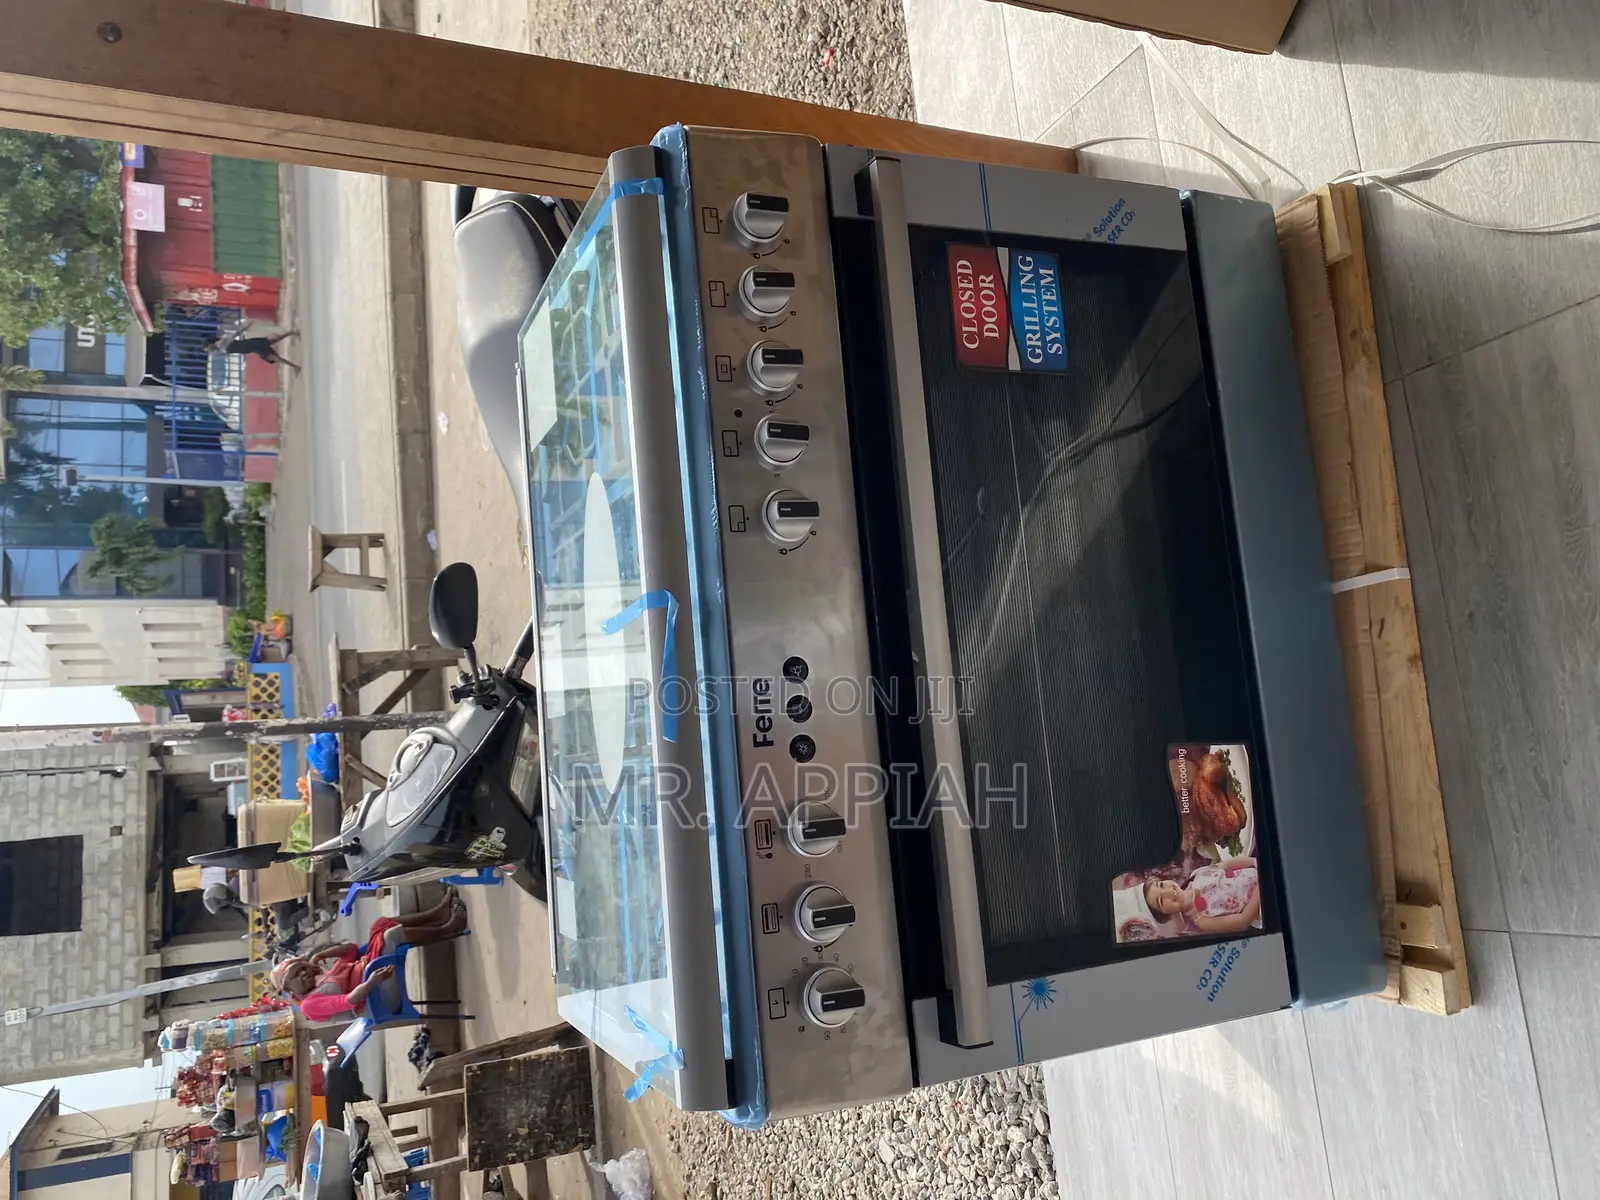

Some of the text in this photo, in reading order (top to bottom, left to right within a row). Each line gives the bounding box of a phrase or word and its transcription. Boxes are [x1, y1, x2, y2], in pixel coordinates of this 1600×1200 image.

[1093, 198, 1126, 237] Solution
[1105, 225, 1124, 244] SER
[956, 259, 980, 349] CLOSED
[978, 273, 1001, 339] DOOR
[1017, 255, 1044, 364] GRILLING
[1038, 267, 1063, 355] SYSTEM
[752, 678, 774, 748] Ferre
[1177, 748, 1190, 814] better cooking
[1207, 947, 1240, 1002] Solution
[1208, 942, 1229, 968] SER
